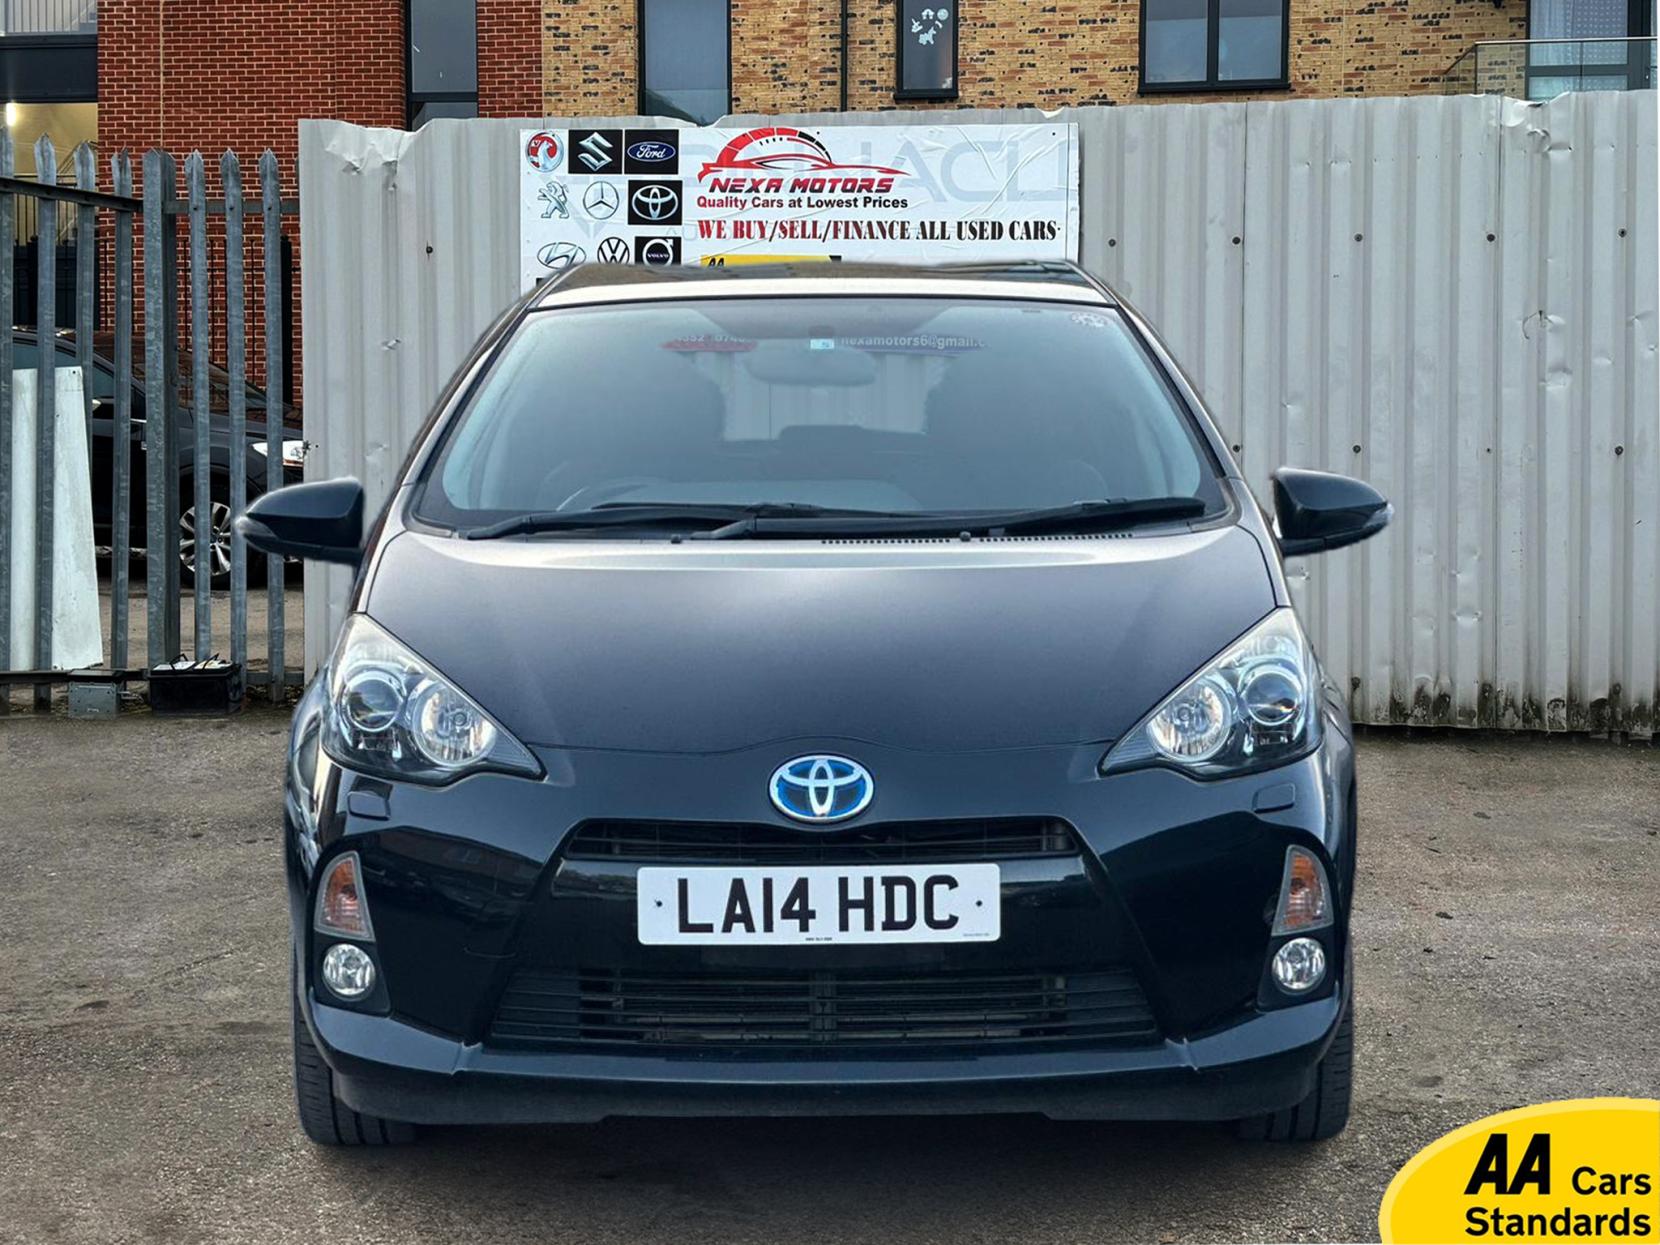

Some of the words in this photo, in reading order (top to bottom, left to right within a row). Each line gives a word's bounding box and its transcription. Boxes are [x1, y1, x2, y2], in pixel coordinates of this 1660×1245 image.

[636, 144, 666, 159] Ford
[709, 178, 784, 193] NEXA
[789, 178, 894, 193] MOTORS
[697, 196, 747, 210] Quality
[751, 196, 784, 208] Cars
[788, 197, 803, 208] at
[807, 196, 858, 208] Lowest
[863, 196, 908, 208] Prices
[698, 220, 727, 239] WE
[916, 220, 950, 240] ALL
[957, 220, 1004, 240] USED
[1009, 220, 1057, 240] CARS
[677, 877, 817, 933] LA14
[838, 874, 960, 932] HDC
